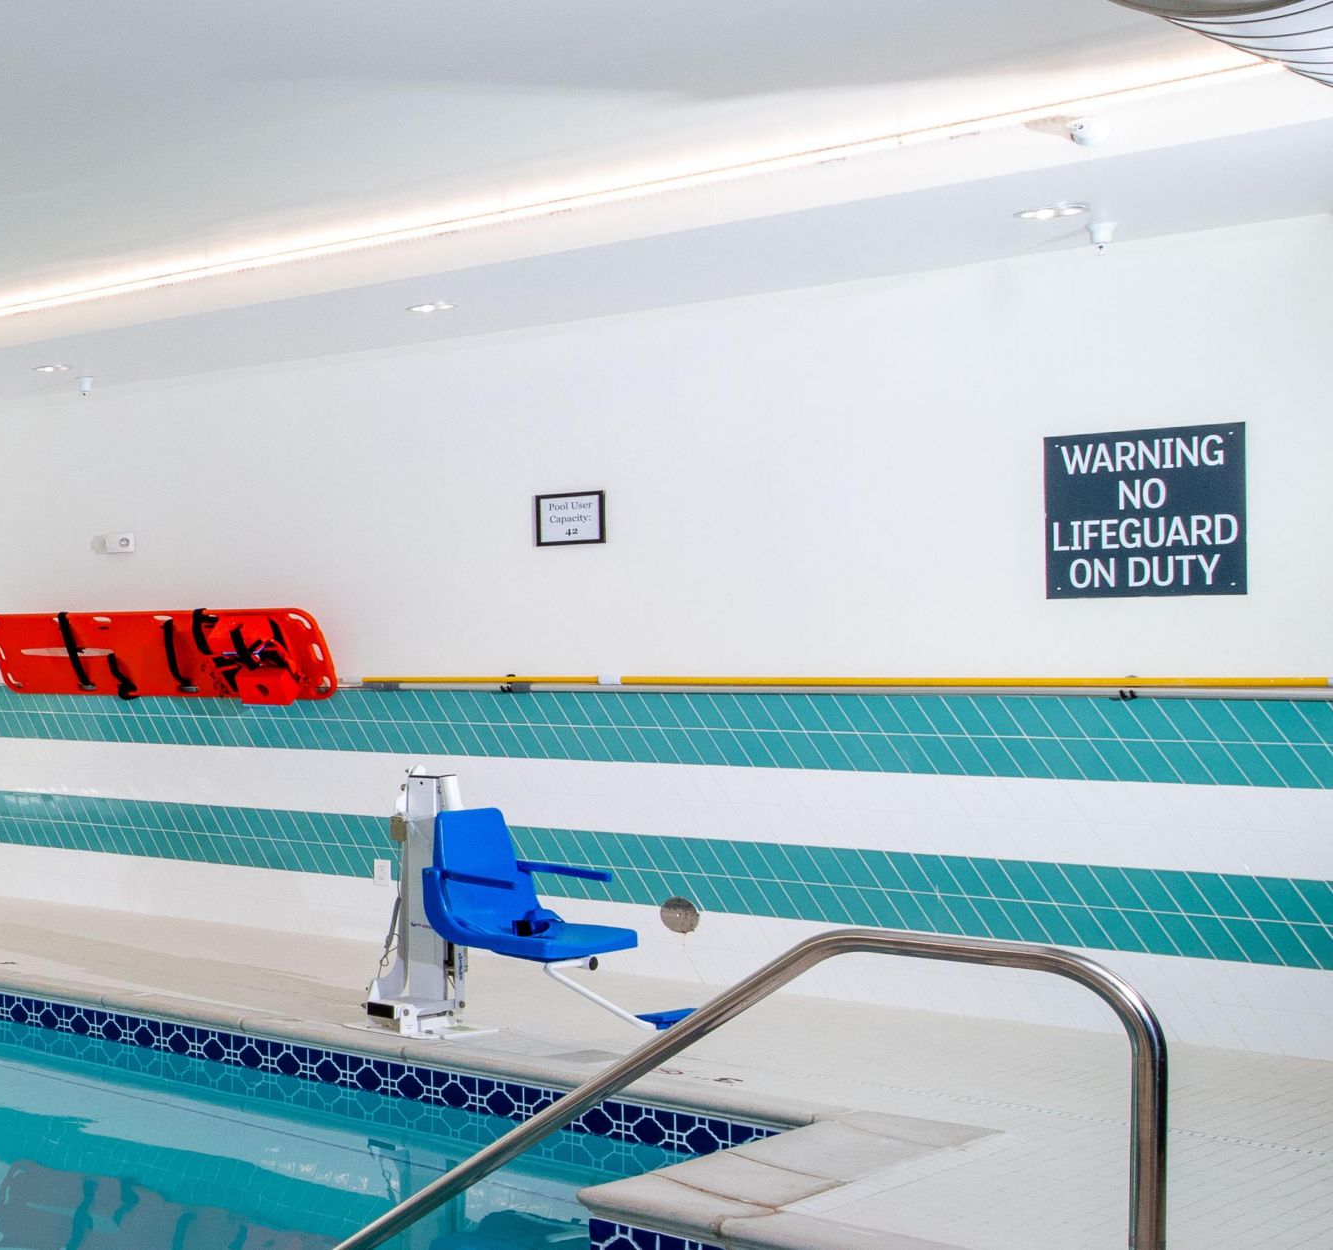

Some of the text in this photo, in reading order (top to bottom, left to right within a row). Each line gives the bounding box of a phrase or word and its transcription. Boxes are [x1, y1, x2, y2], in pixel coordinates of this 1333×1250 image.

[1060, 434, 1224, 475] WARNING
[549, 501, 592, 511] Pool User
[1118, 477, 1166, 511] NO
[549, 514, 591, 524] Capacity:
[565, 528, 578, 537] 42
[1052, 513, 1239, 552] LIFEGUARD
[1069, 553, 1221, 589] ON DUTY
